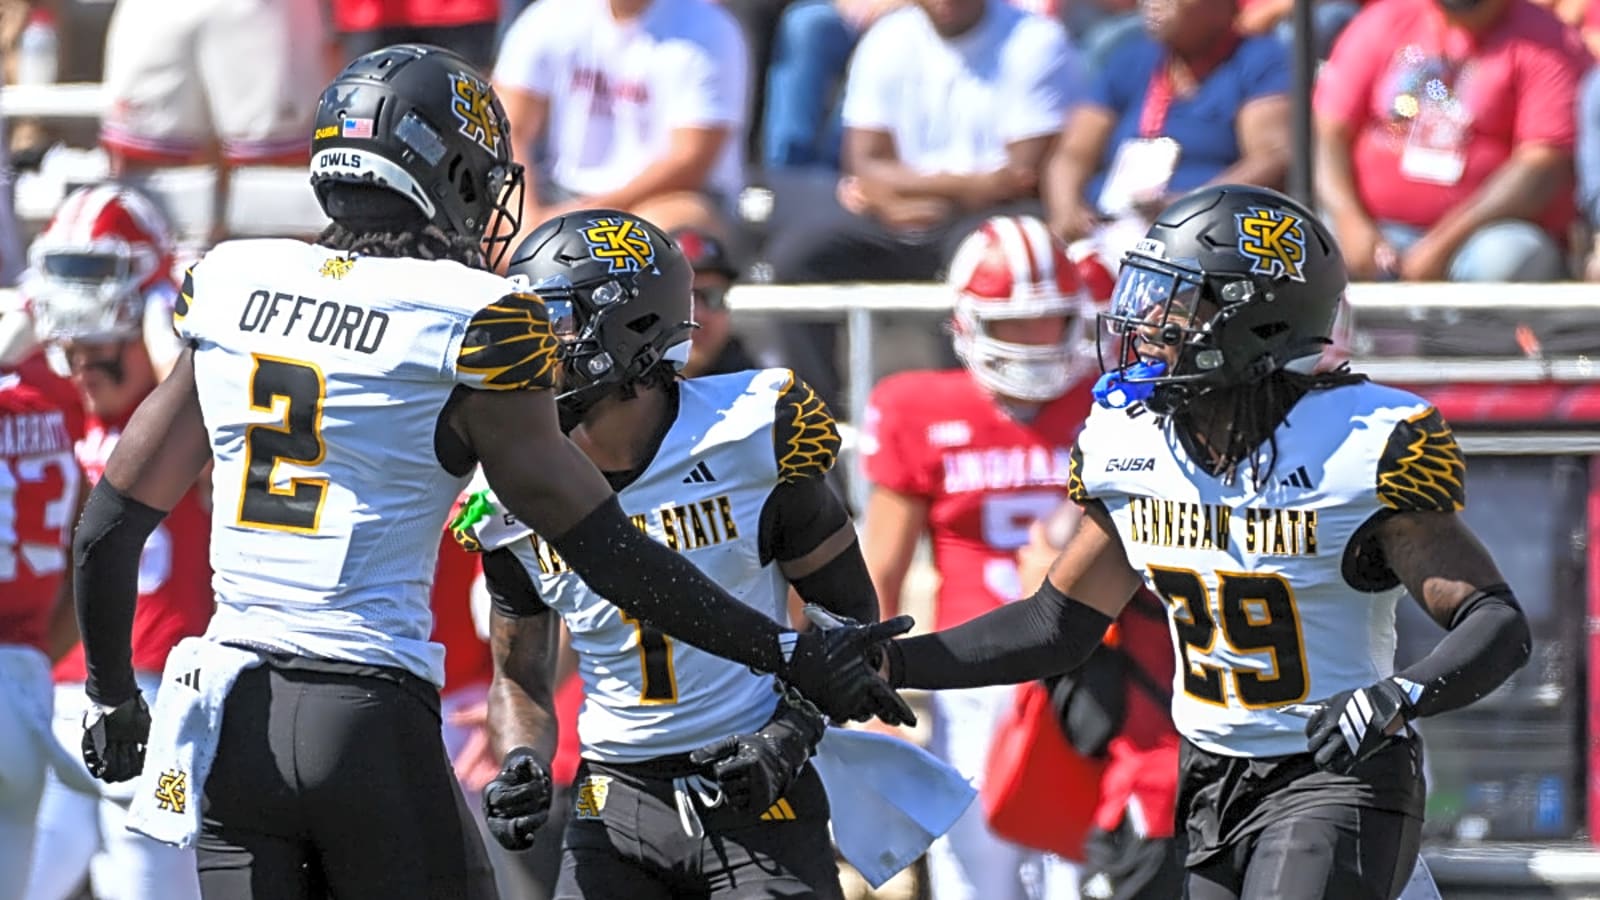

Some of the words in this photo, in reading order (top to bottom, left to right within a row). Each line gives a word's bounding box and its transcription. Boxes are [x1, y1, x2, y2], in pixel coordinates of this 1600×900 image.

[320, 152, 361, 169] OWLS
[239, 289, 390, 355] OFFORD
[236, 351, 330, 534] 2
[659, 495, 740, 552] STATE
[1128, 495, 1233, 551] KENNESAW
[1245, 506, 1319, 556] STATE
[1146, 563, 1311, 711] 29
